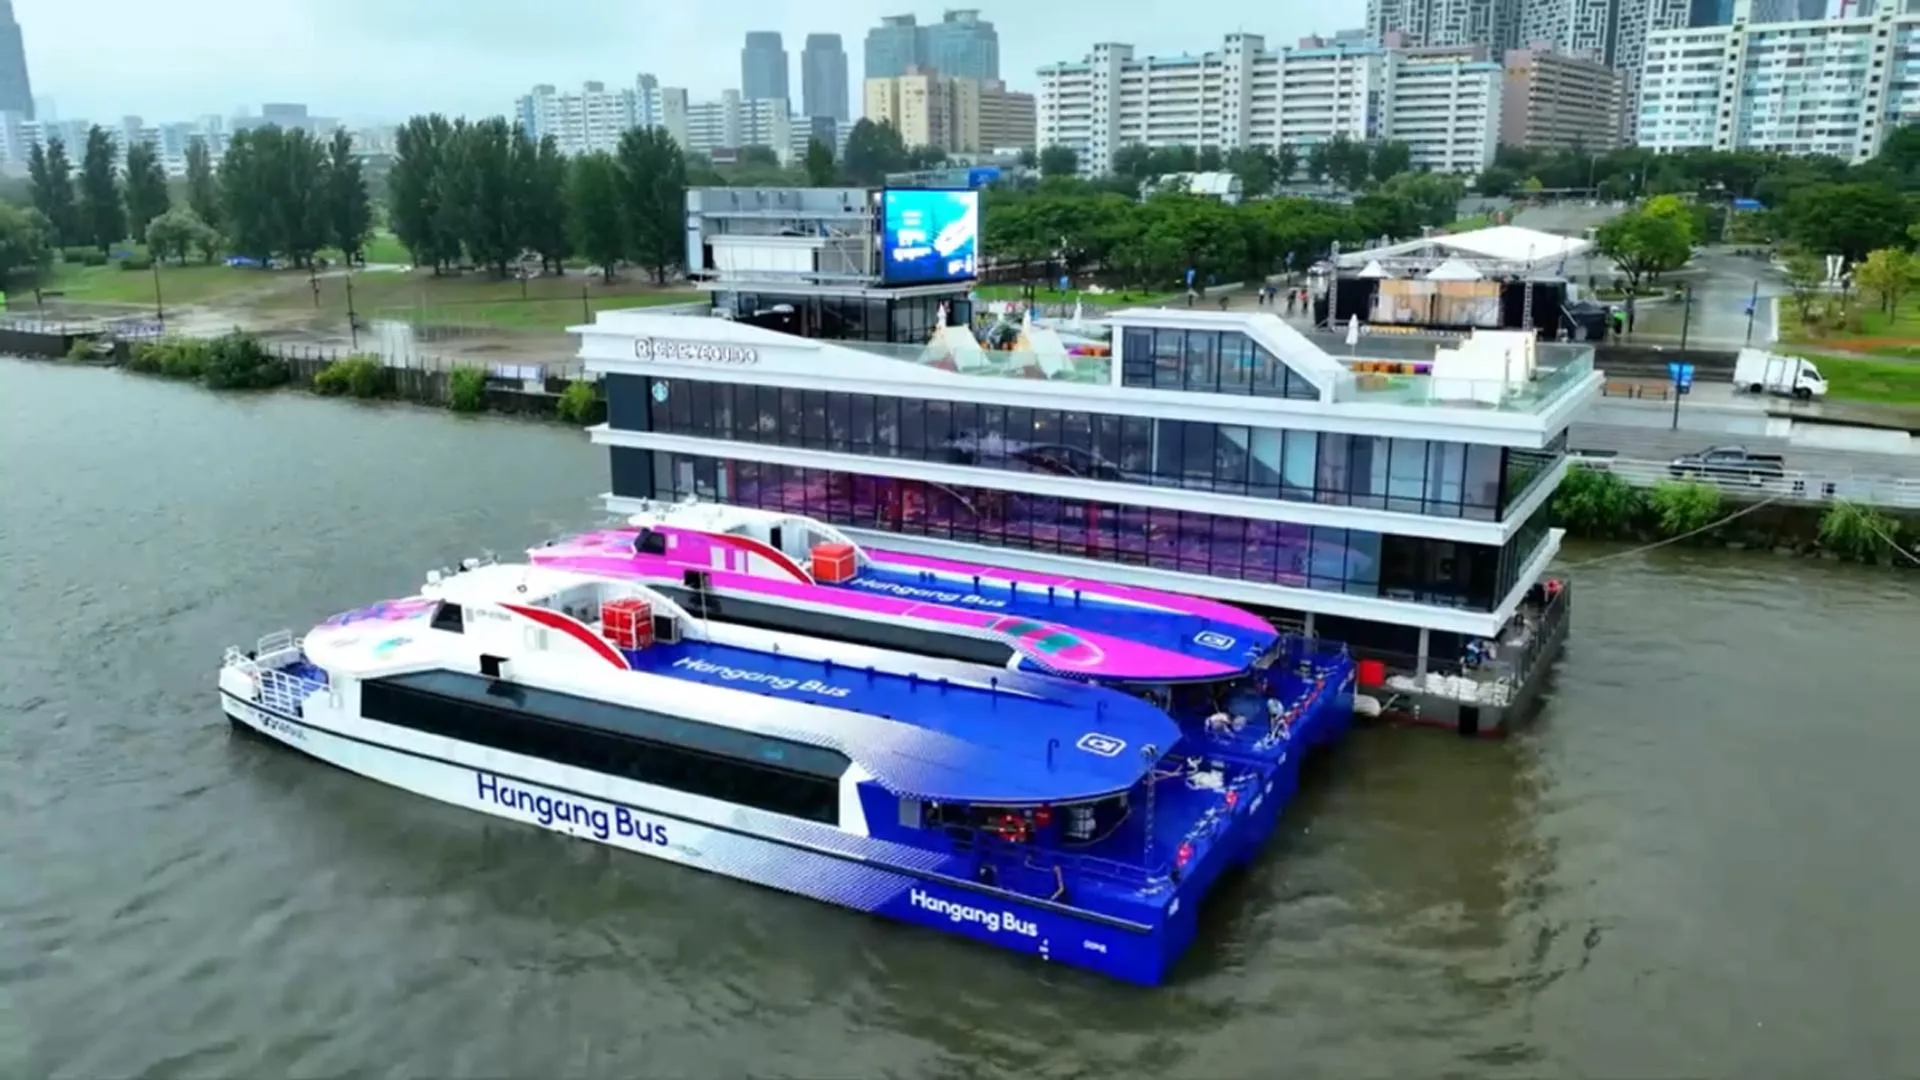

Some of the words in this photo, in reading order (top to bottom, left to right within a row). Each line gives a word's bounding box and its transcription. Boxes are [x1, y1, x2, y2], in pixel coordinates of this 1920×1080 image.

[850, 577, 961, 602] Hangang
[959, 594, 1007, 608] Bus
[672, 656, 799, 690] Hangang
[797, 679, 852, 698] Bus
[477, 772, 609, 840] Hangang
[615, 805, 669, 847] Bus
[910, 888, 1000, 932] Hangang
[1002, 911, 1038, 937] Bus
